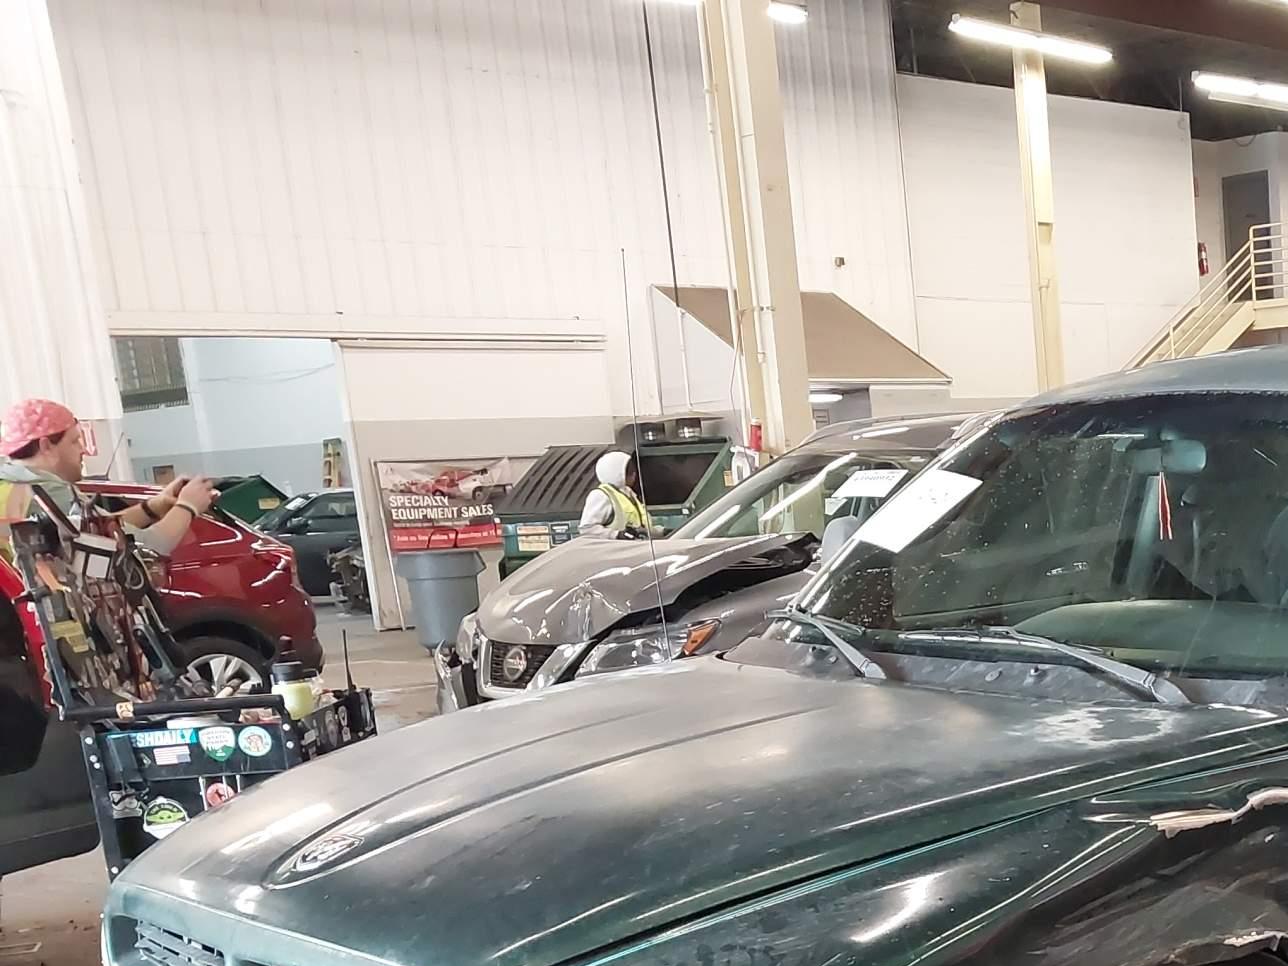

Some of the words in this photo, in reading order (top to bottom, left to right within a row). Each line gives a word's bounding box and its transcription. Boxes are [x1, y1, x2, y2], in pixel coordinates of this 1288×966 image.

[389, 495, 449, 508] SPECIALTY
[391, 507, 458, 520] EQUIPMENT
[460, 504, 494, 518] SALES
